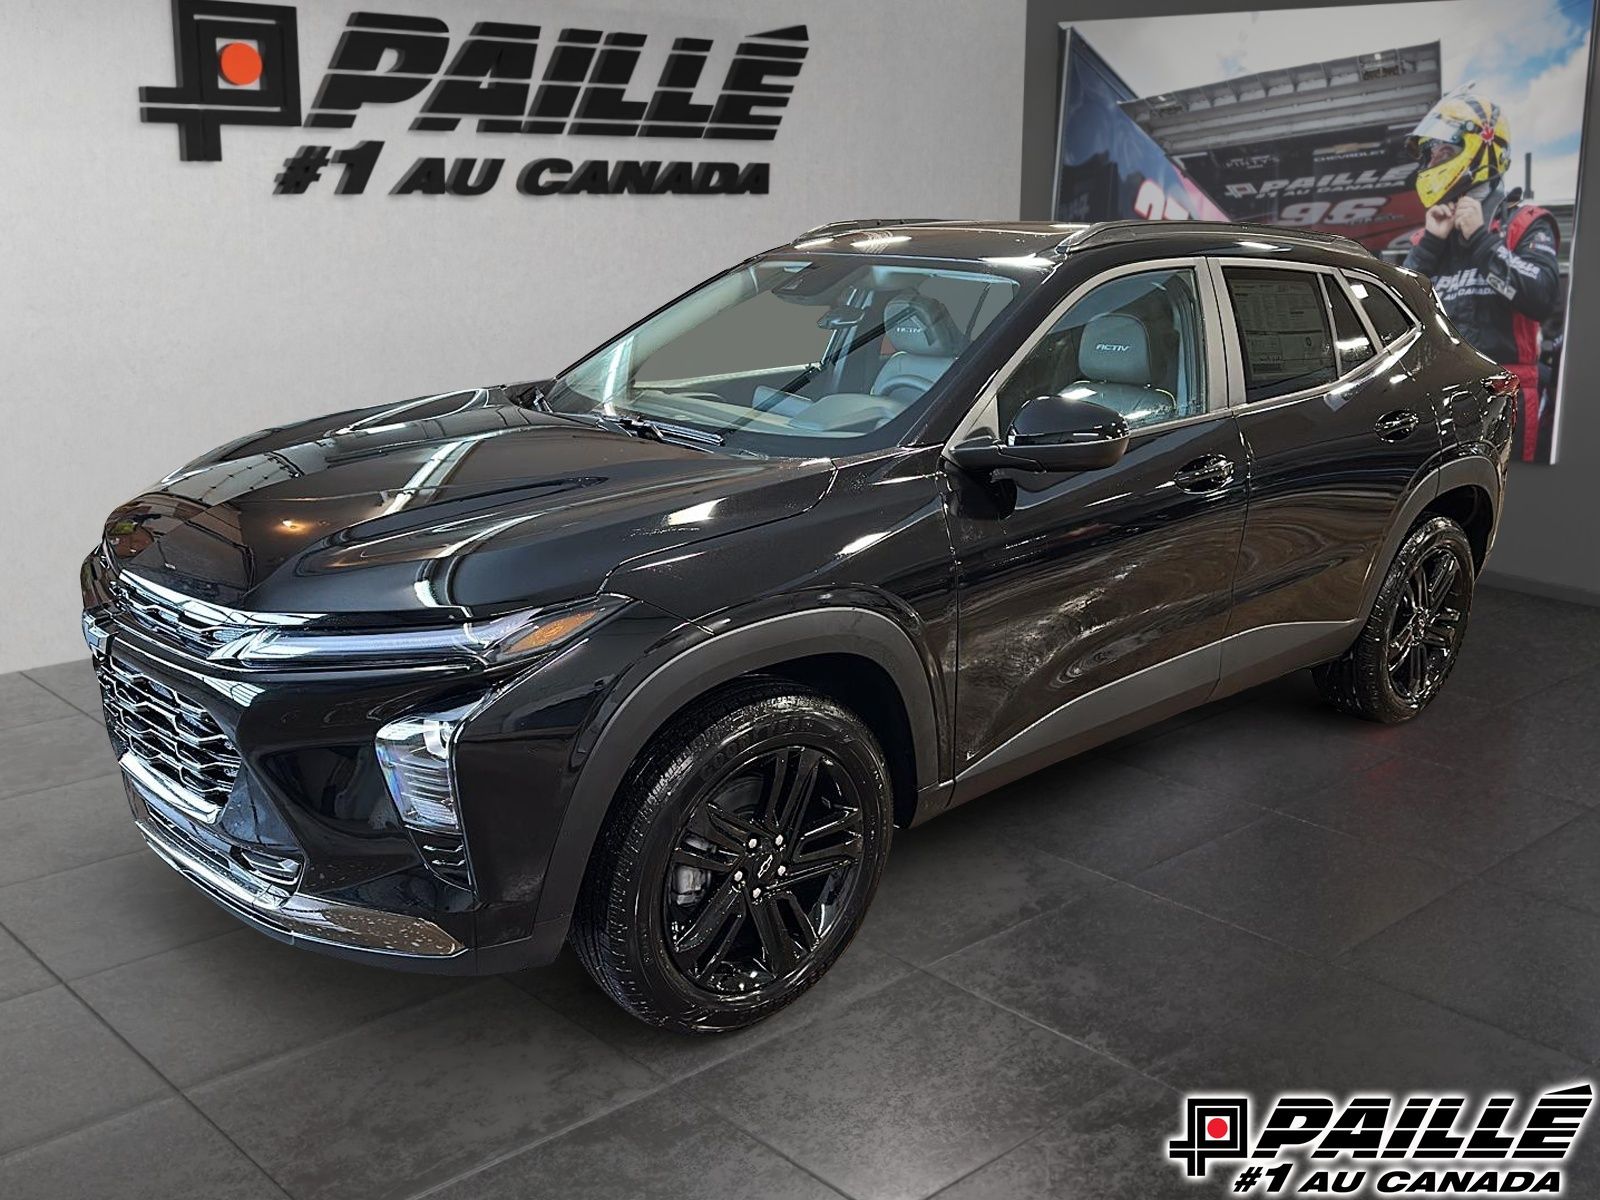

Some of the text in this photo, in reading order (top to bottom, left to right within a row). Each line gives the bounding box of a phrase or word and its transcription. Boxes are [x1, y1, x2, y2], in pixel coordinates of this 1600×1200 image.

[303, 11, 810, 140] PAILLÉ
[1313, 150, 1386, 162] CHEVROLET
[272, 140, 770, 195] #1 AU CANADA
[1317, 180, 1405, 193] CANADA
[1275, 197, 1387, 226] 96
[1096, 343, 1131, 352] ACTIV
